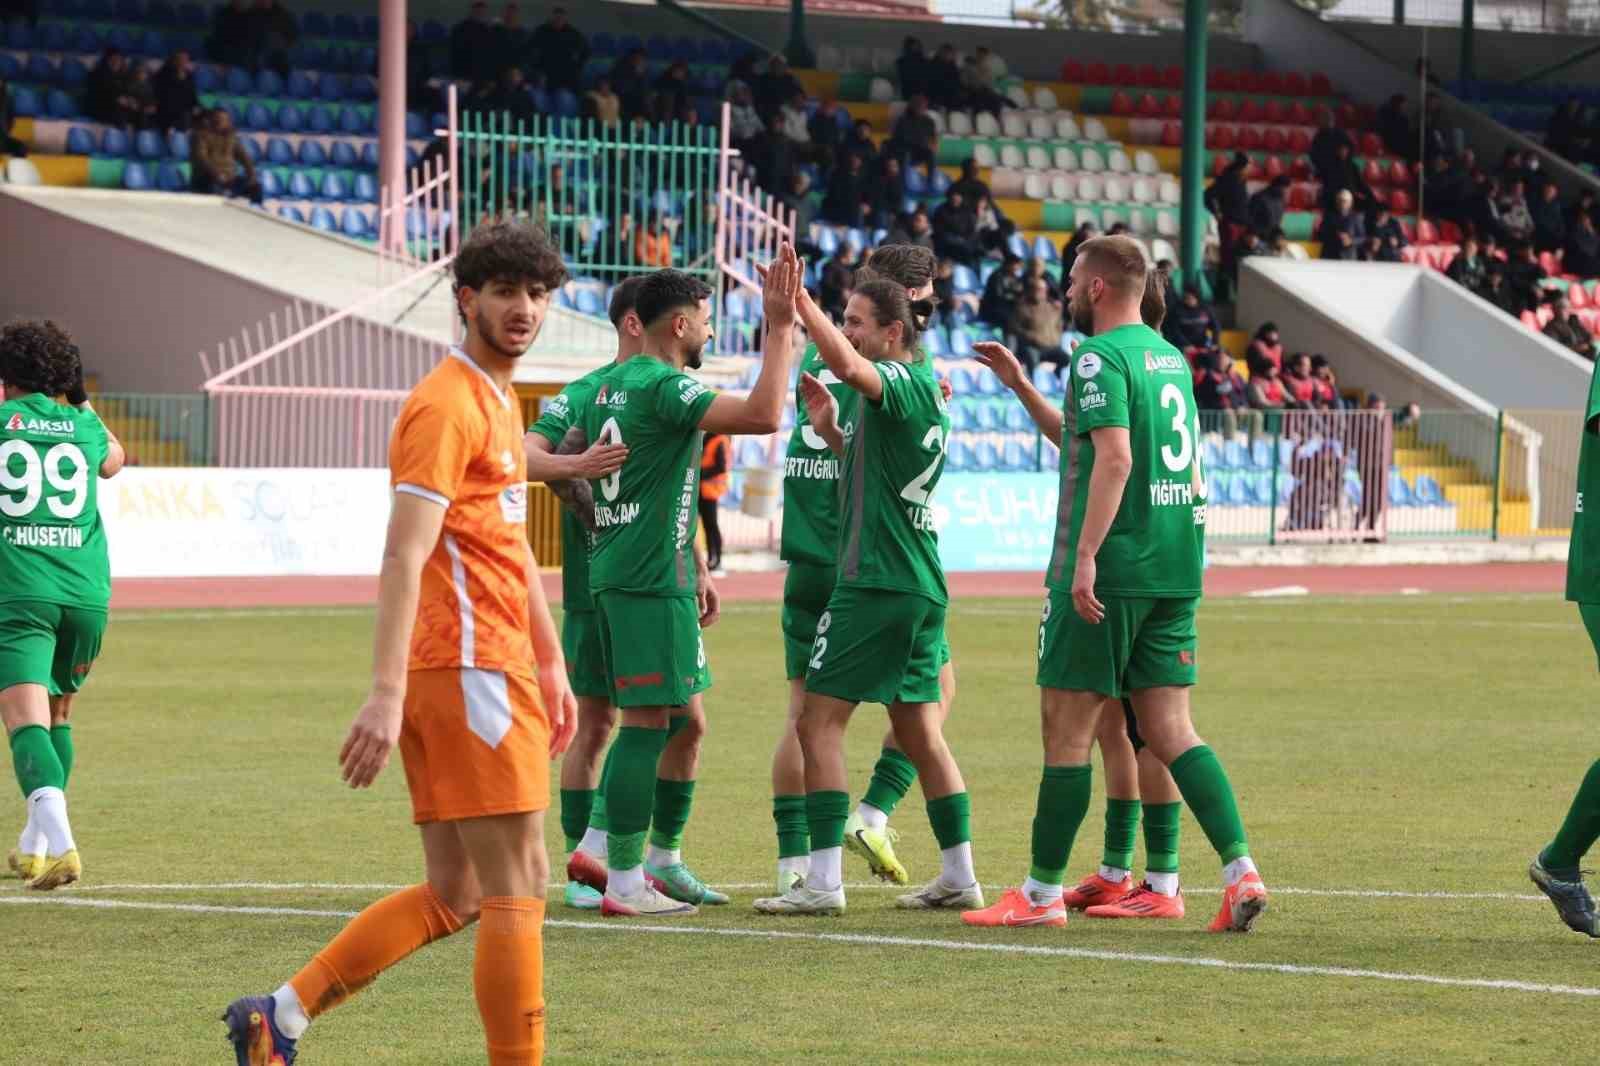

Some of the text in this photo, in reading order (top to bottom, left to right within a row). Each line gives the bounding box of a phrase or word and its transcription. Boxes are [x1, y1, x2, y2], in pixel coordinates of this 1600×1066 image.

[27, 419, 75, 433] AKSU
[0, 439, 88, 518] 99
[900, 425, 949, 505] 2
[118, 479, 224, 521] ANKA
